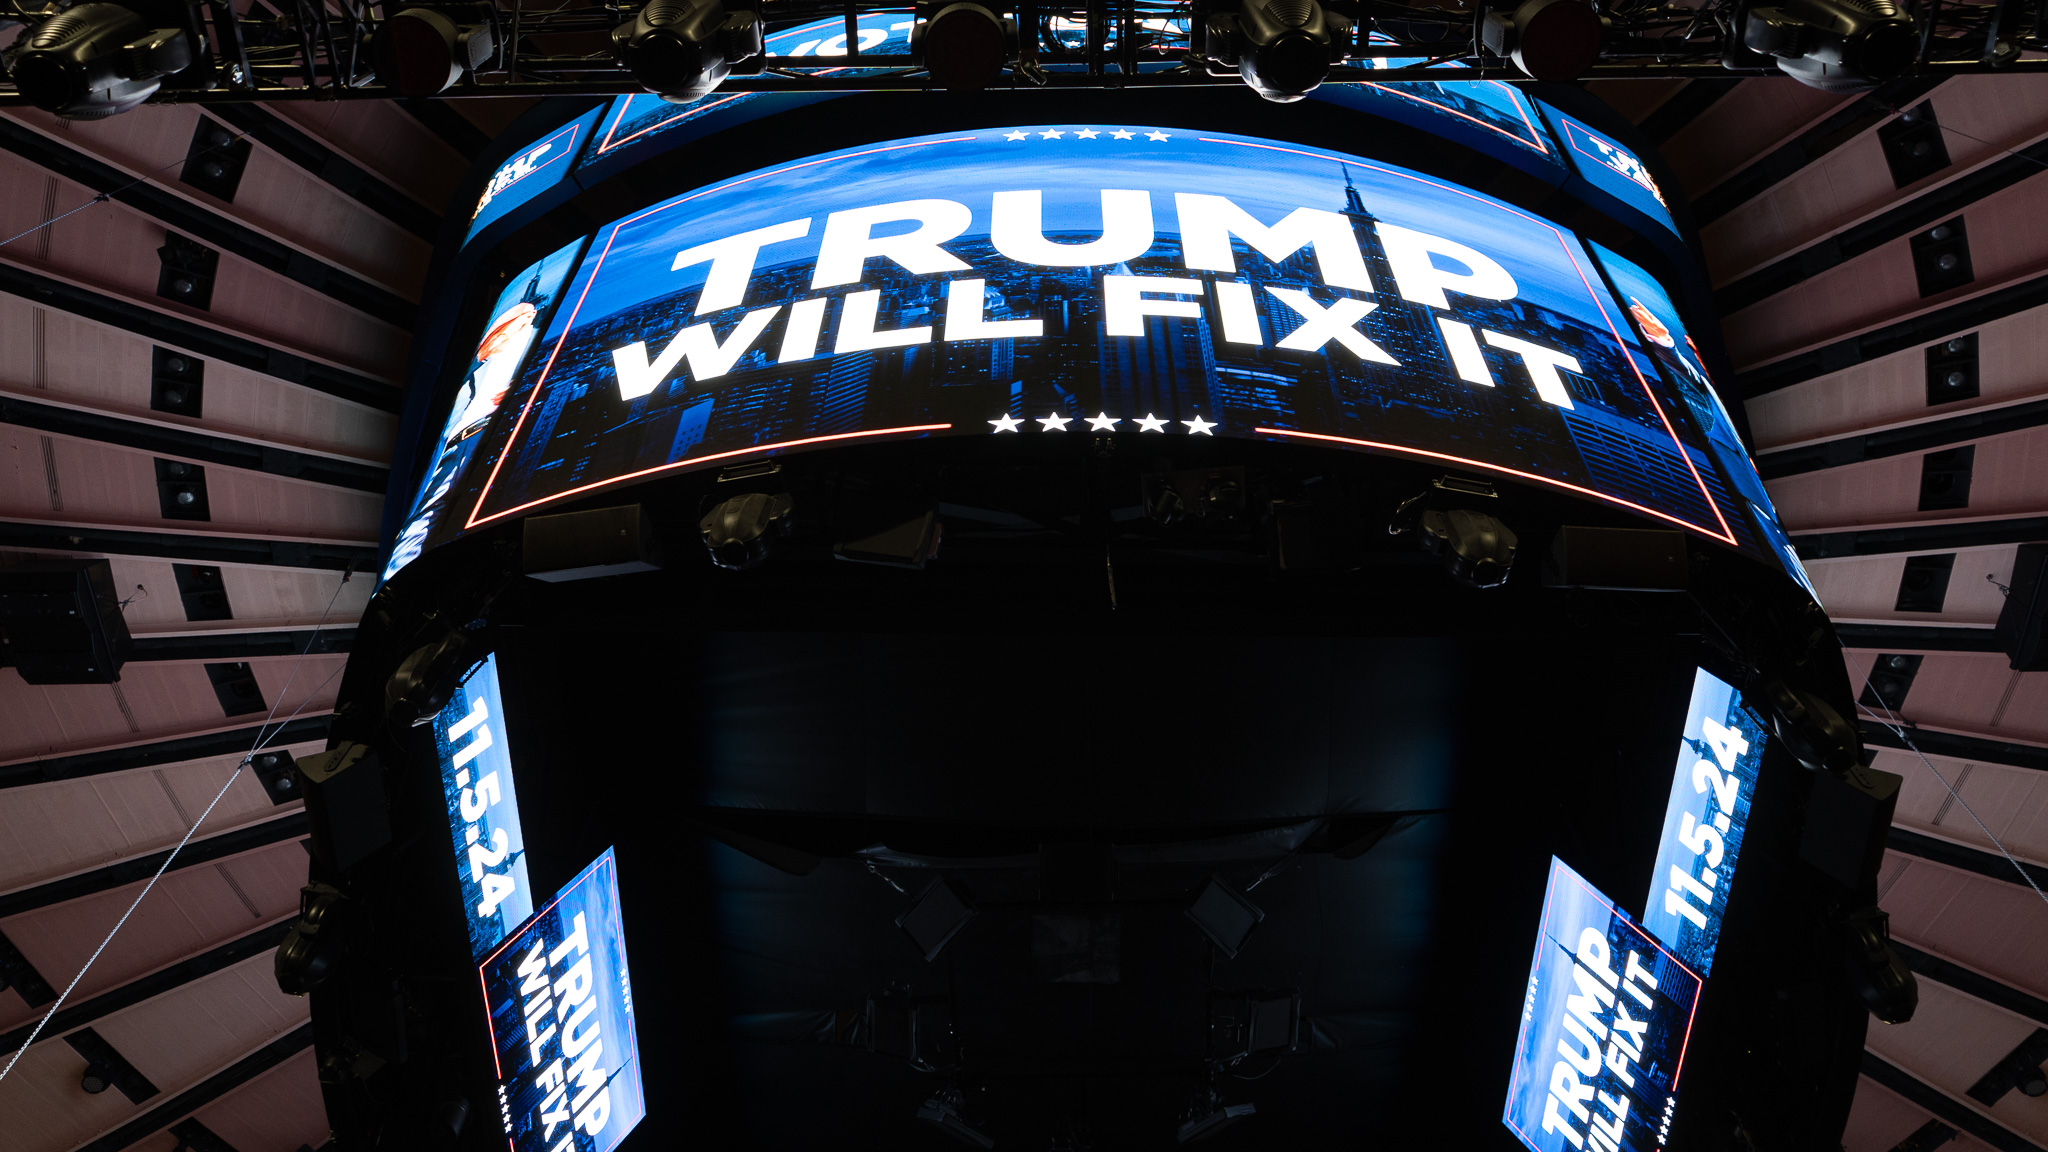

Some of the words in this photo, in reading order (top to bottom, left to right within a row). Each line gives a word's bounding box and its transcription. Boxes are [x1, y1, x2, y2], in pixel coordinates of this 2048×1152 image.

[671, 189, 1518, 317] TRUMP
[612, 278, 1044, 401] WILL
[1103, 275, 1401, 366] FIX
[1437, 317, 1583, 411] IT
[447, 695, 516, 918] 11.5.24
[1664, 715, 1750, 931] 11.5.24
[517, 937, 557, 1068] WILL
[548, 910, 611, 1137] TRUMP
[1541, 926, 1621, 1151] TRUMP
[1605, 1000, 1649, 1089] FIX
[1622, 949, 1659, 1011] IT
[535, 1056, 571, 1143] FIX
